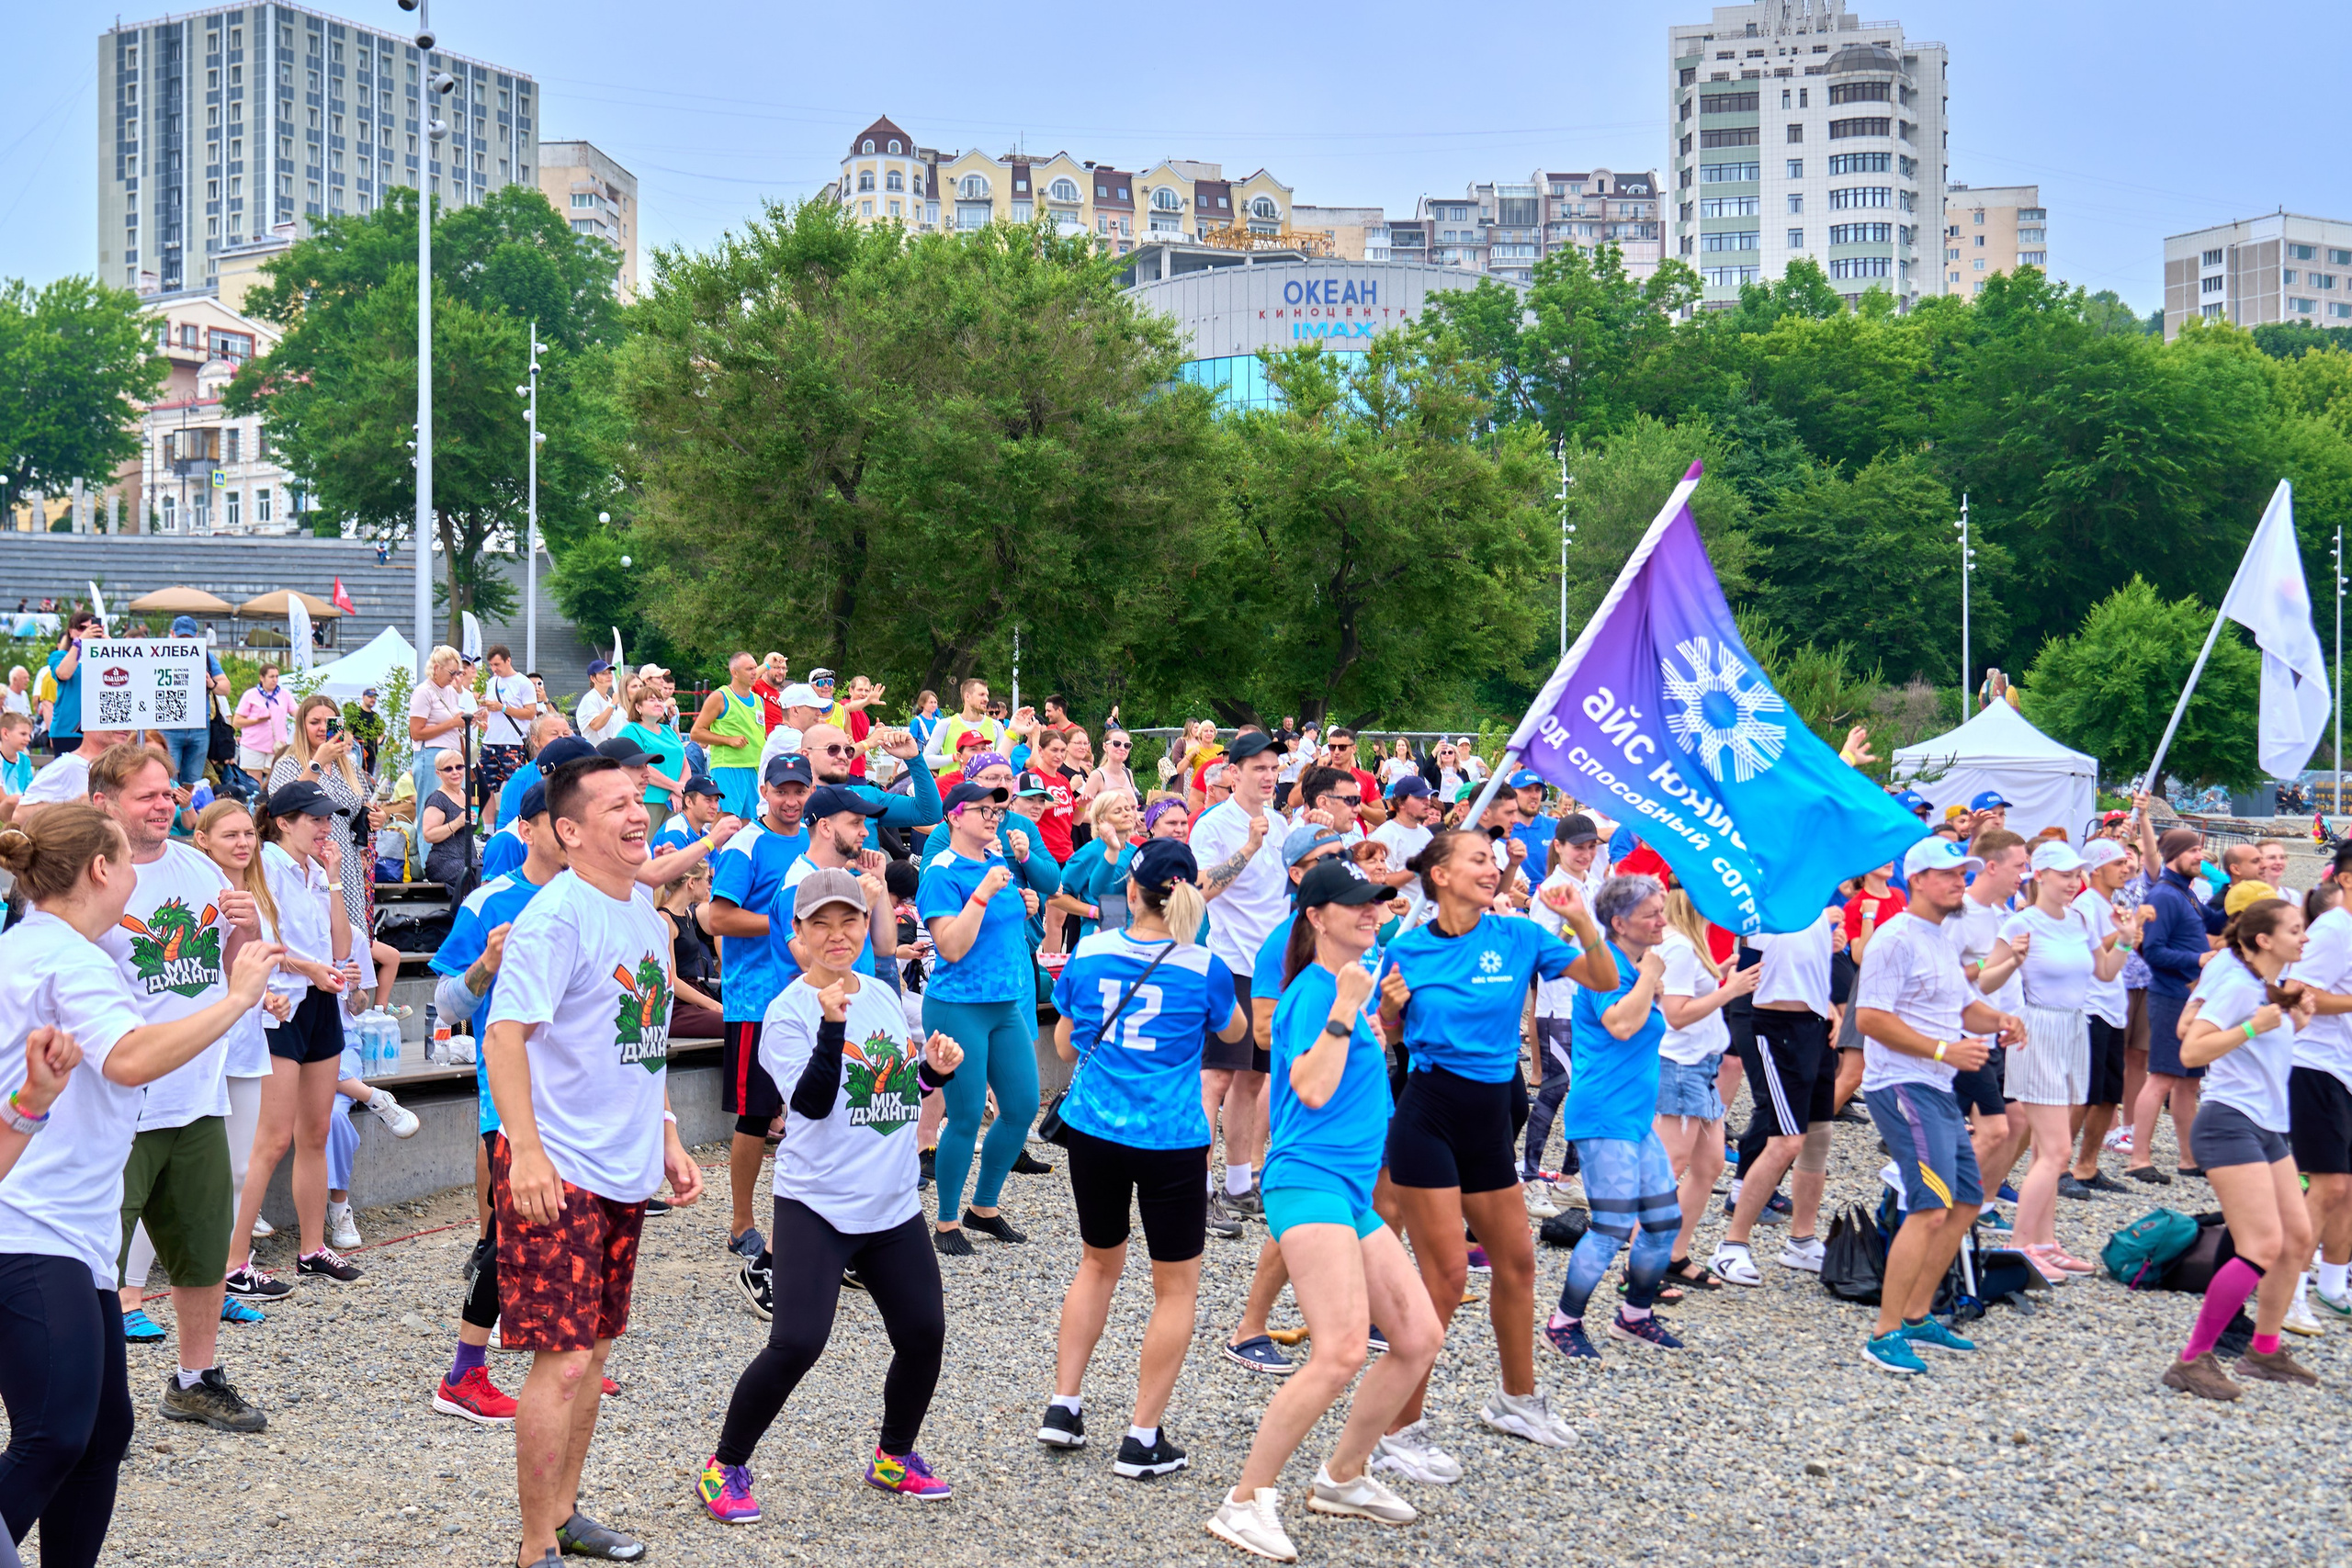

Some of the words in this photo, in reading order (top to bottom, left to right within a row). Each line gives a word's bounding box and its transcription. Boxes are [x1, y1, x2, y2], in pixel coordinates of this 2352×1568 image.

[1283, 279, 1377, 305] ОКЕАН
[1259, 307, 1407, 320] КИНОЦЕНТР
[1293, 321, 1374, 340] IMAX
[90, 646, 143, 658] БАНКА
[150, 645, 200, 658] ХЛЕБА
[148, 968, 220, 993] ДЖАНГЛ
[1098, 977, 1164, 1052] 12
[622, 1041, 666, 1063] ДЖАН
[852, 1105, 918, 1125] ДЖАНГЛ
